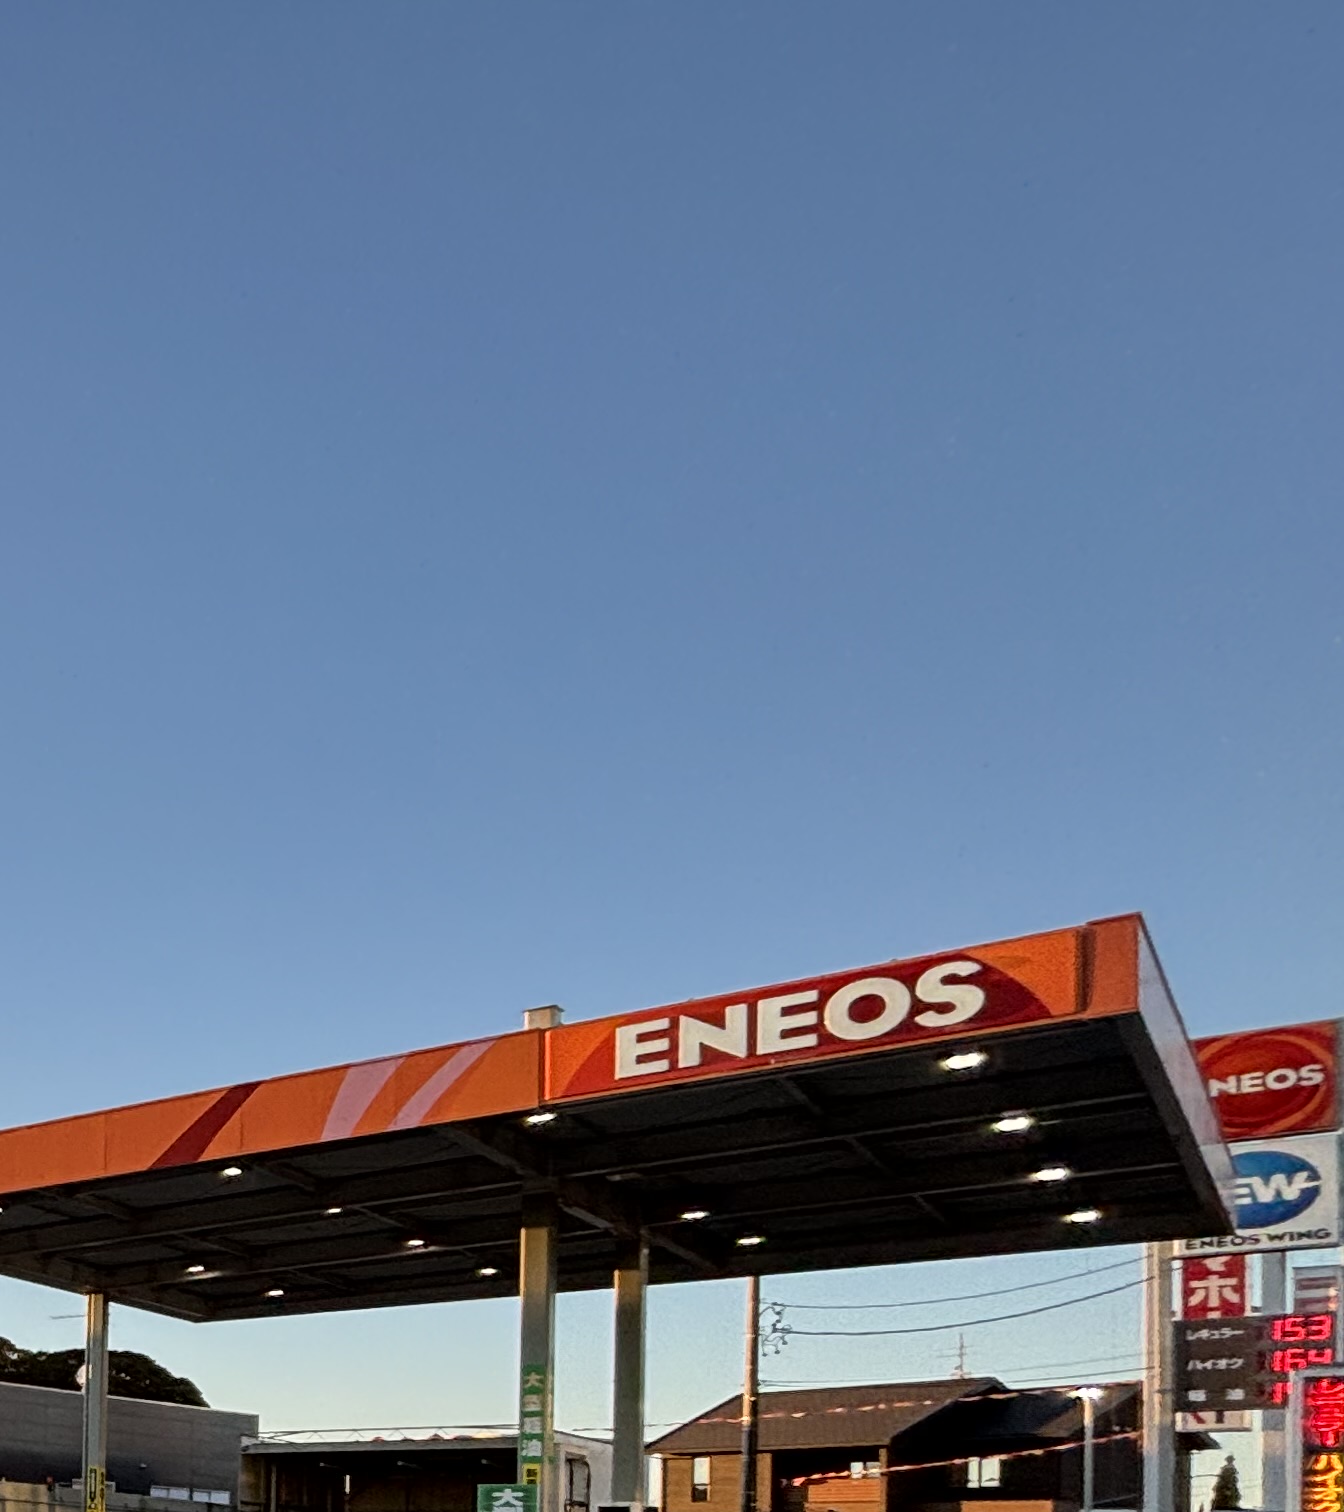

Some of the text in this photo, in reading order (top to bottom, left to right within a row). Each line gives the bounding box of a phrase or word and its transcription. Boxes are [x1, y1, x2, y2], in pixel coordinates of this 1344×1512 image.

[614, 960, 985, 1080] ENEOS
[1209, 1064, 1325, 1097] NEOS
[1186, 1228, 1331, 1250] ENEOS WING
[1272, 1314, 1333, 1341] 153
[1187, 1348, 1333, 1373] ハイオク 164
